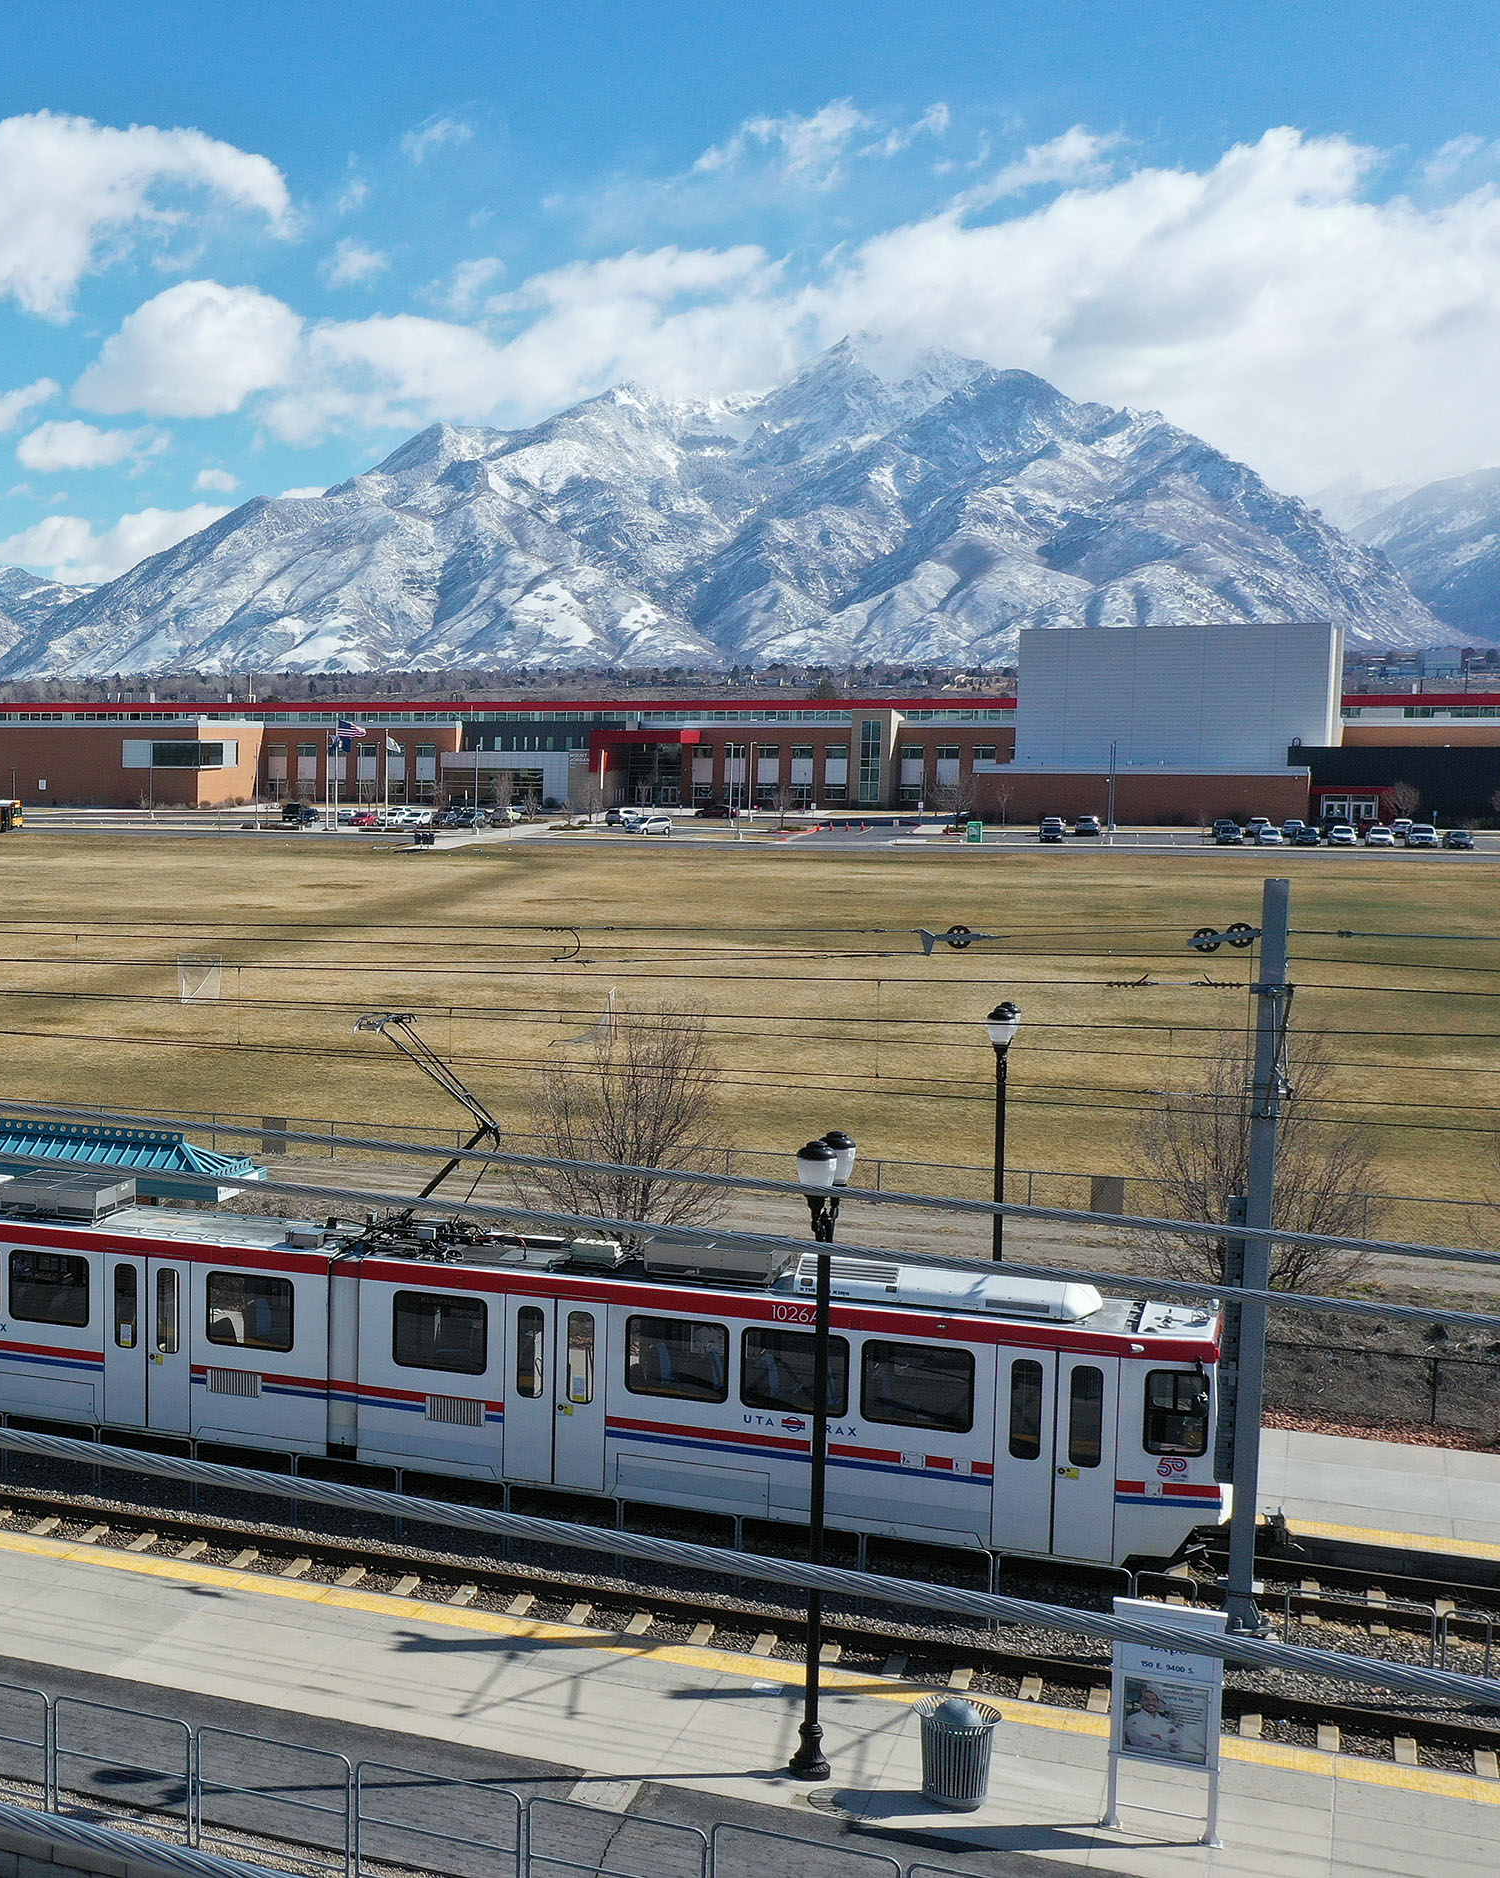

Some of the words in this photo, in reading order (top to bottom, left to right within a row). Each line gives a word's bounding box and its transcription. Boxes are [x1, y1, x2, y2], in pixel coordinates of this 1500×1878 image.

[743, 1414, 775, 1427] UTA
[826, 1424, 857, 1437] RAX
[1156, 1457, 1187, 1477] 50
[1141, 1660, 1154, 1668] 150
[1165, 1664, 1186, 1673] 9400
